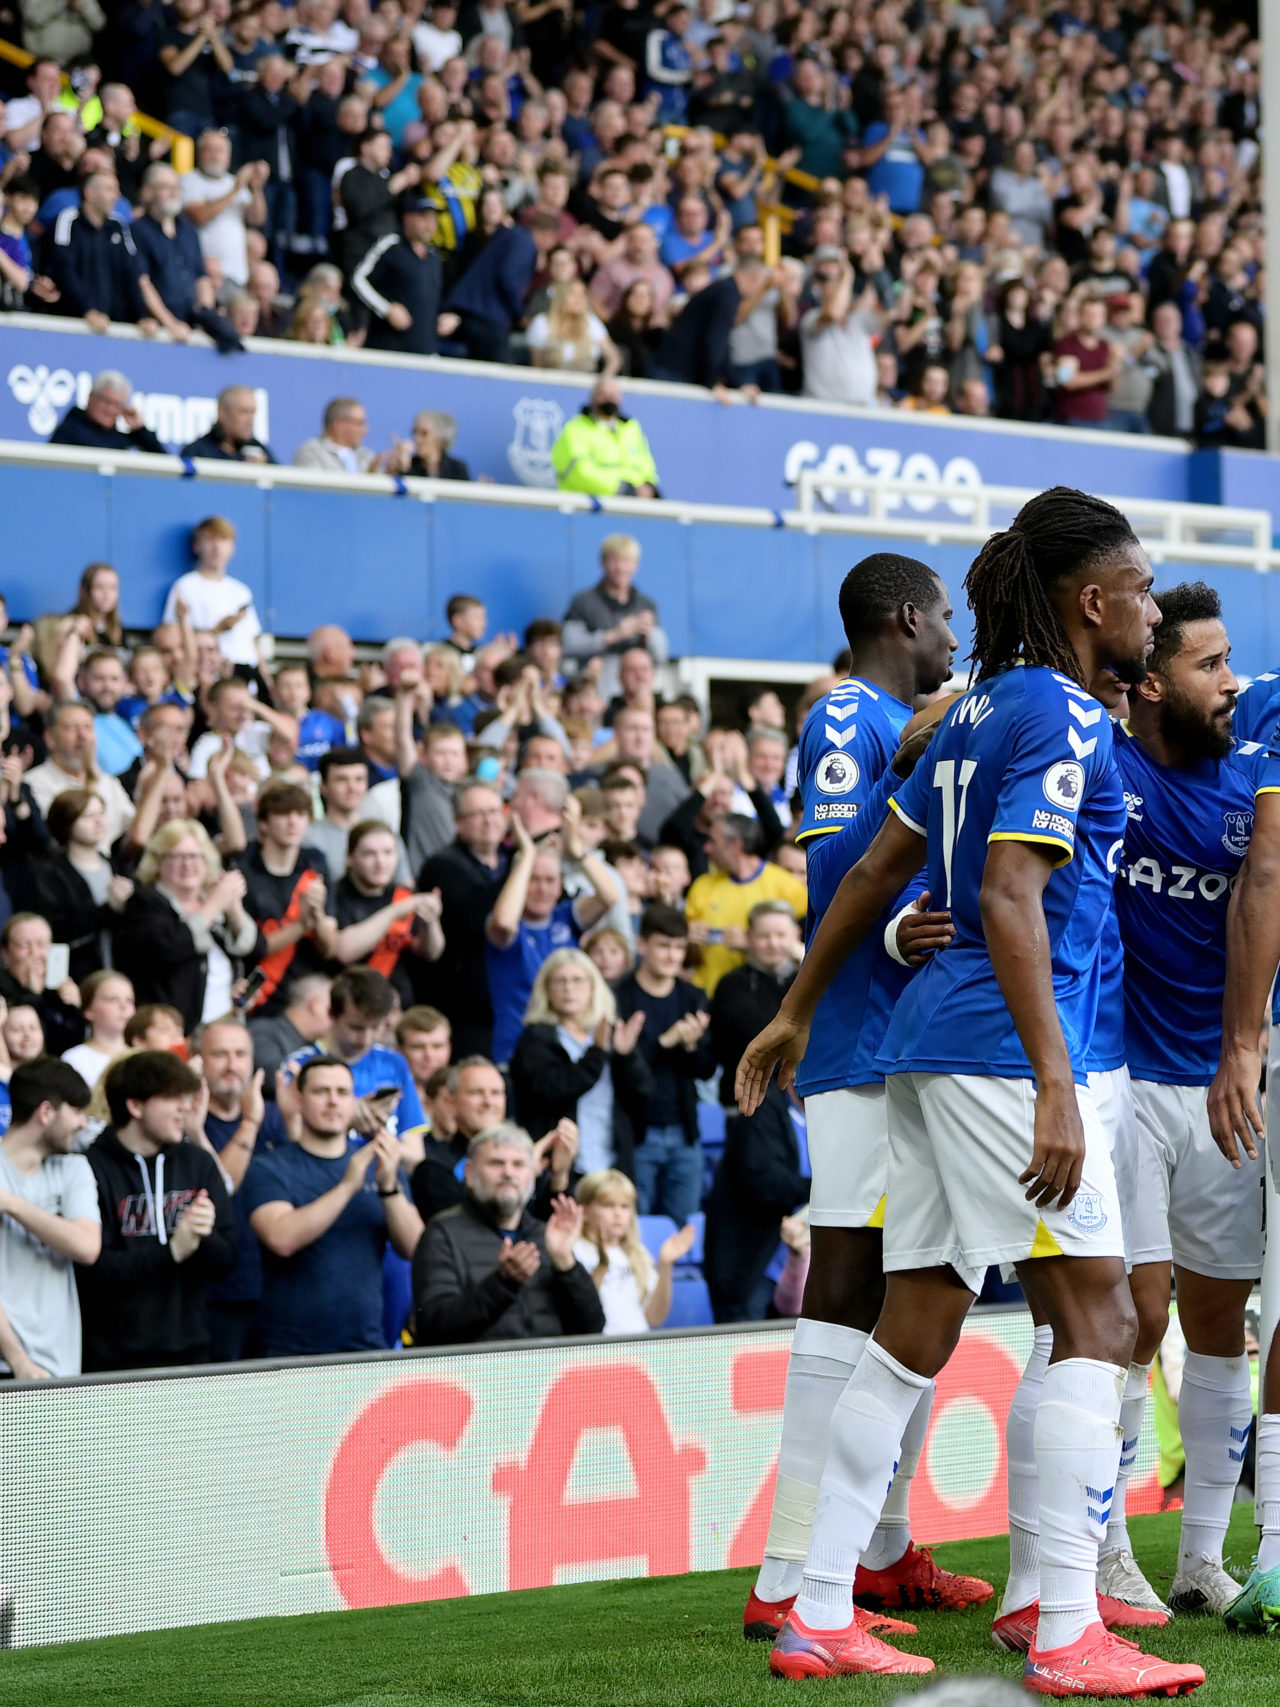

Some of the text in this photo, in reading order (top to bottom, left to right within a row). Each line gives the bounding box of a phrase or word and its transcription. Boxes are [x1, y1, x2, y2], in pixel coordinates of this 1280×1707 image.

[814, 812, 828, 821] for
[815, 803, 857, 813] No room
[1034, 809, 1075, 833] No room
[1032, 1662, 1086, 1691] ULTRA
